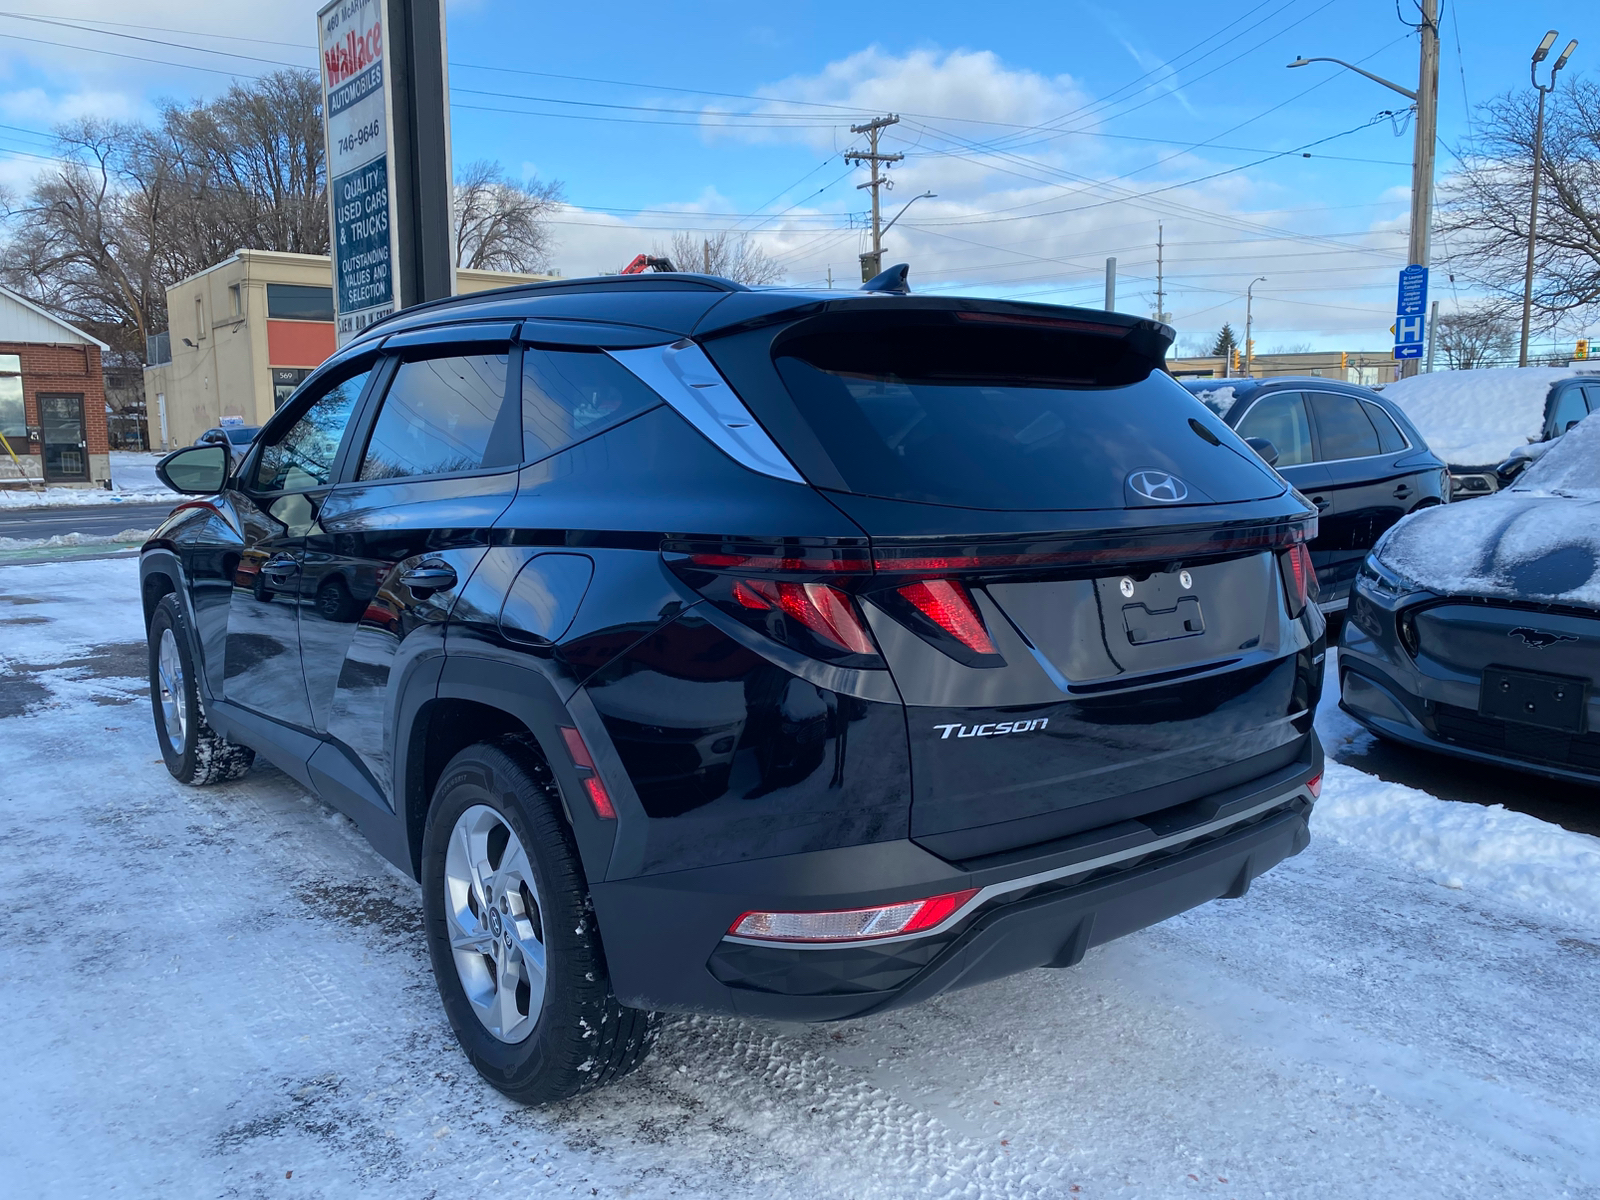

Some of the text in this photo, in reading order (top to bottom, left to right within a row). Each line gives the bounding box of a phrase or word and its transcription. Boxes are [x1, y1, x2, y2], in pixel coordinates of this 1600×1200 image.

[327, 13, 339, 32] 460
[325, 21, 382, 88] Wallace
[332, 65, 381, 110] AUTOMOBILES
[338, 119, 380, 155] 746-9646
[344, 169, 379, 200] QUALITY
[338, 187, 387, 223] USED CARS
[340, 210, 388, 246] & TRUCKS
[342, 245, 389, 273] OUTSTANDING
[345, 263, 387, 288] VALUES AND
[348, 281, 386, 304] SELECTION
[1399, 317, 1421, 342] H
